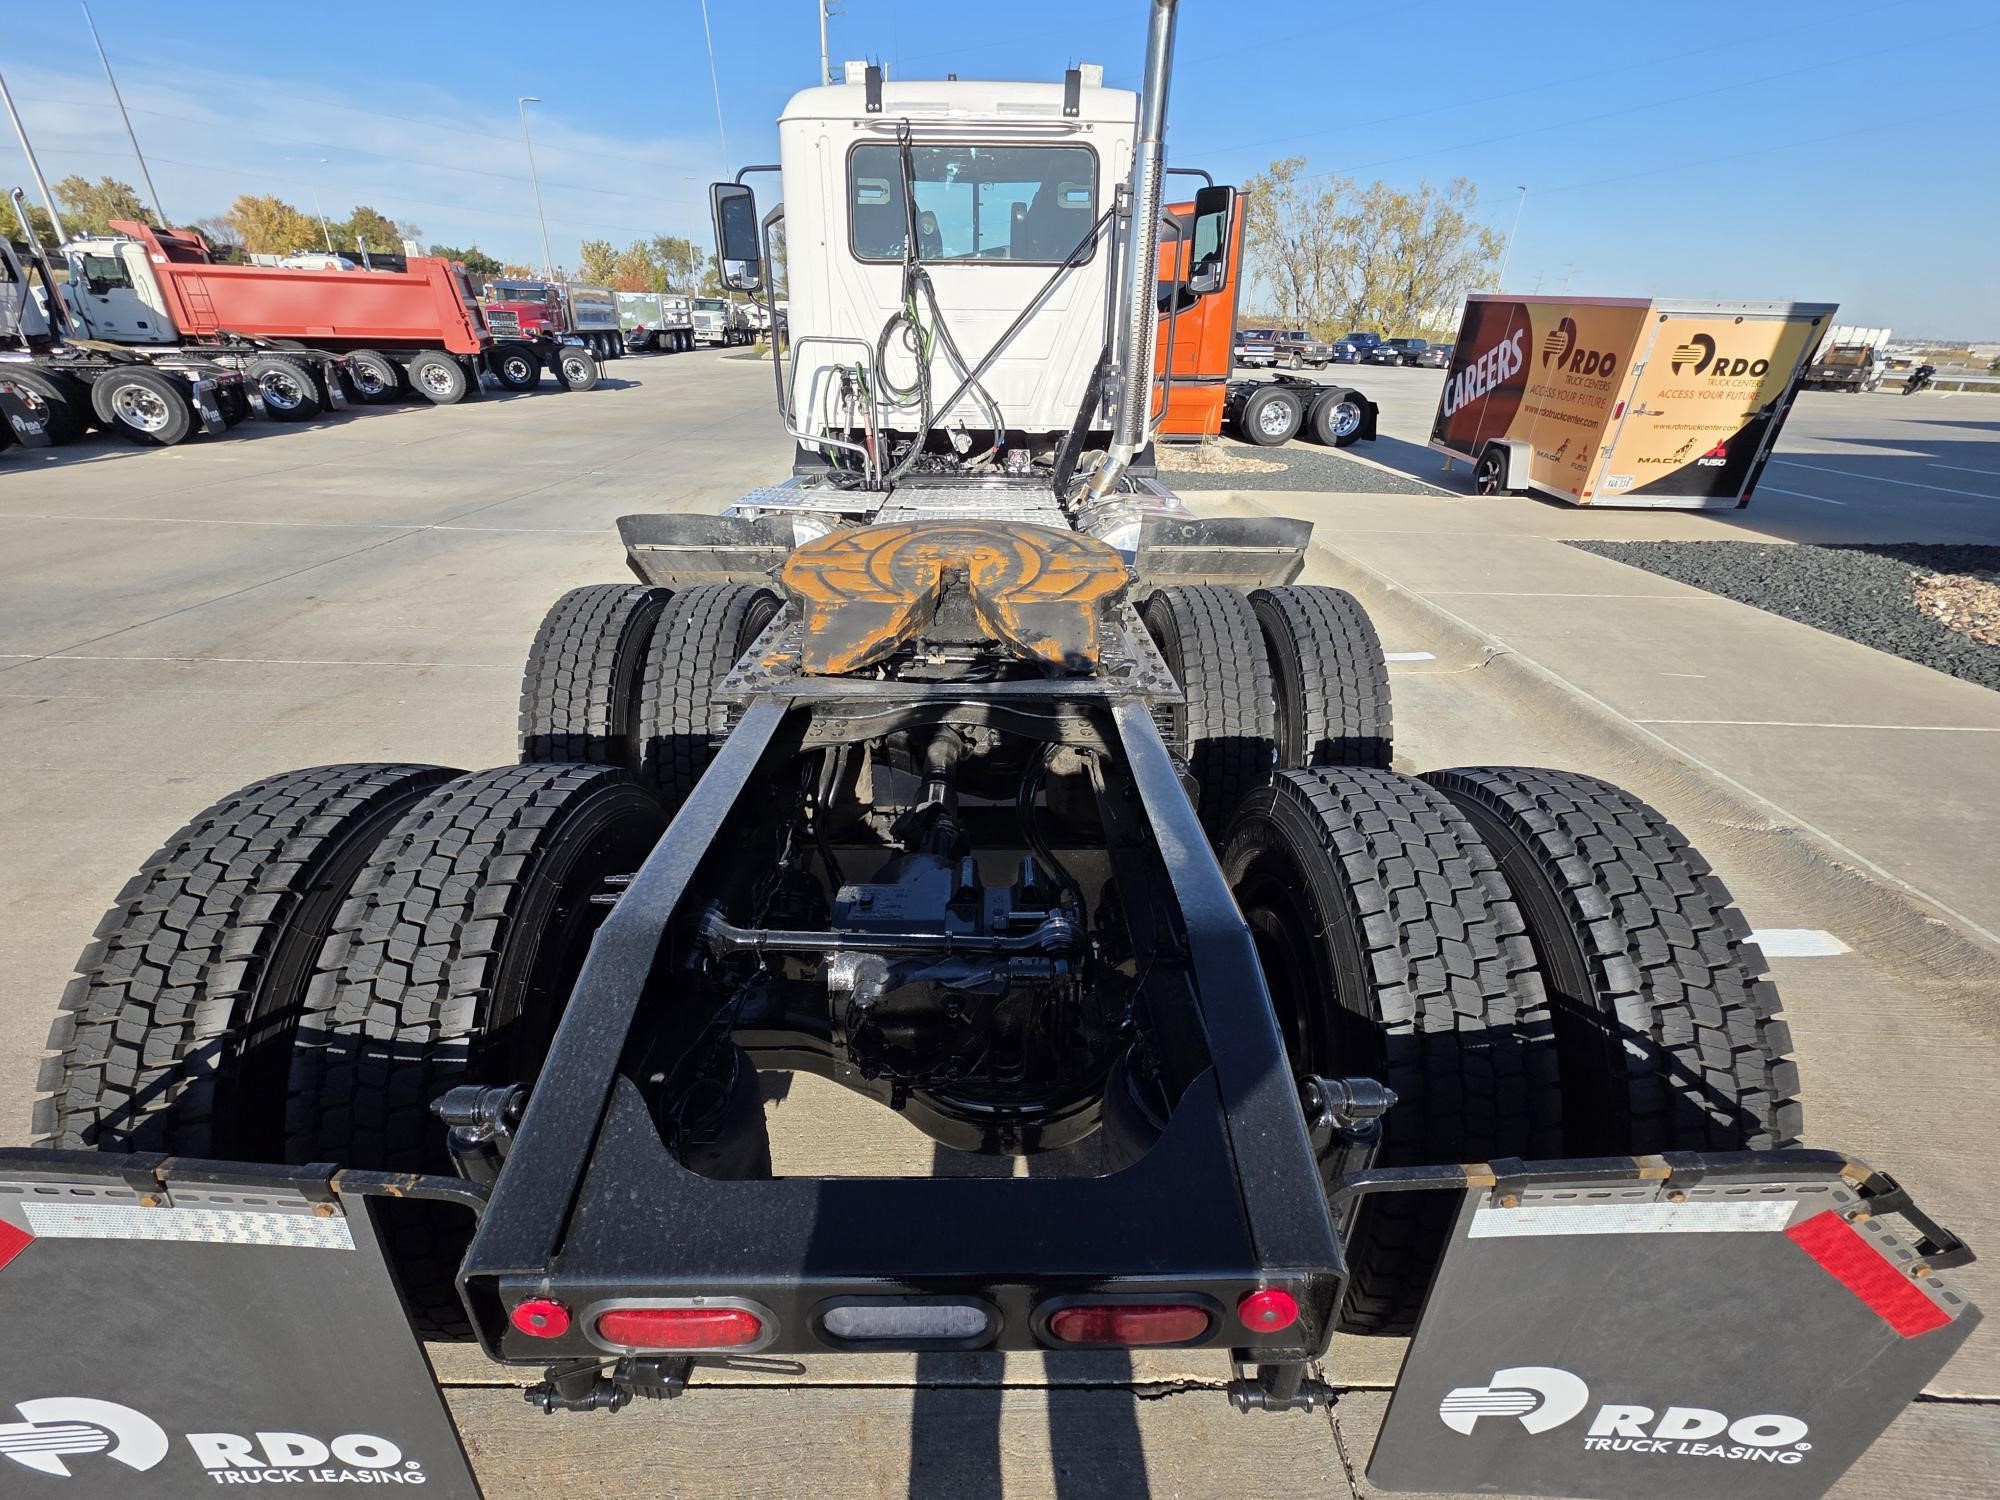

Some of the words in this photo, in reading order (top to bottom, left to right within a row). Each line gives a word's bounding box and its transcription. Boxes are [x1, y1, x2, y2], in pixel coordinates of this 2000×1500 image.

[1568, 348, 1617, 378] RDO
[1710, 357, 1770, 378] RDO
[1443, 328, 1524, 418] CAREERS
[1565, 375, 1583, 387] TRUCK
[1583, 377, 1612, 392] CENTERS
[1706, 378, 1730, 388] TRUCK
[1731, 379, 1766, 388] CENTERS
[1529, 384, 1556, 399] ACCESS
[1558, 388, 1578, 402] YOUR
[1579, 393, 1607, 409] FUTURE
[1656, 390, 1695, 399] ACCESS
[1698, 390, 1724, 400] YOUR
[1725, 391, 1761, 401] FUTURE
[1524, 404, 1599, 429] www.rdotruckcenter.com
[1653, 423, 1738, 432] www.rdotruckcenter.com
[1536, 450, 1561, 463] MACK
[1697, 458, 1727, 467] FUSO
[1570, 462, 1588, 473] FUSO
[1584, 1437, 1673, 1454] TRUCK
[1676, 1441, 1804, 1465] LEASING
[207, 1469, 305, 1484] TRUCK
[308, 1469, 426, 1484] LEASING
